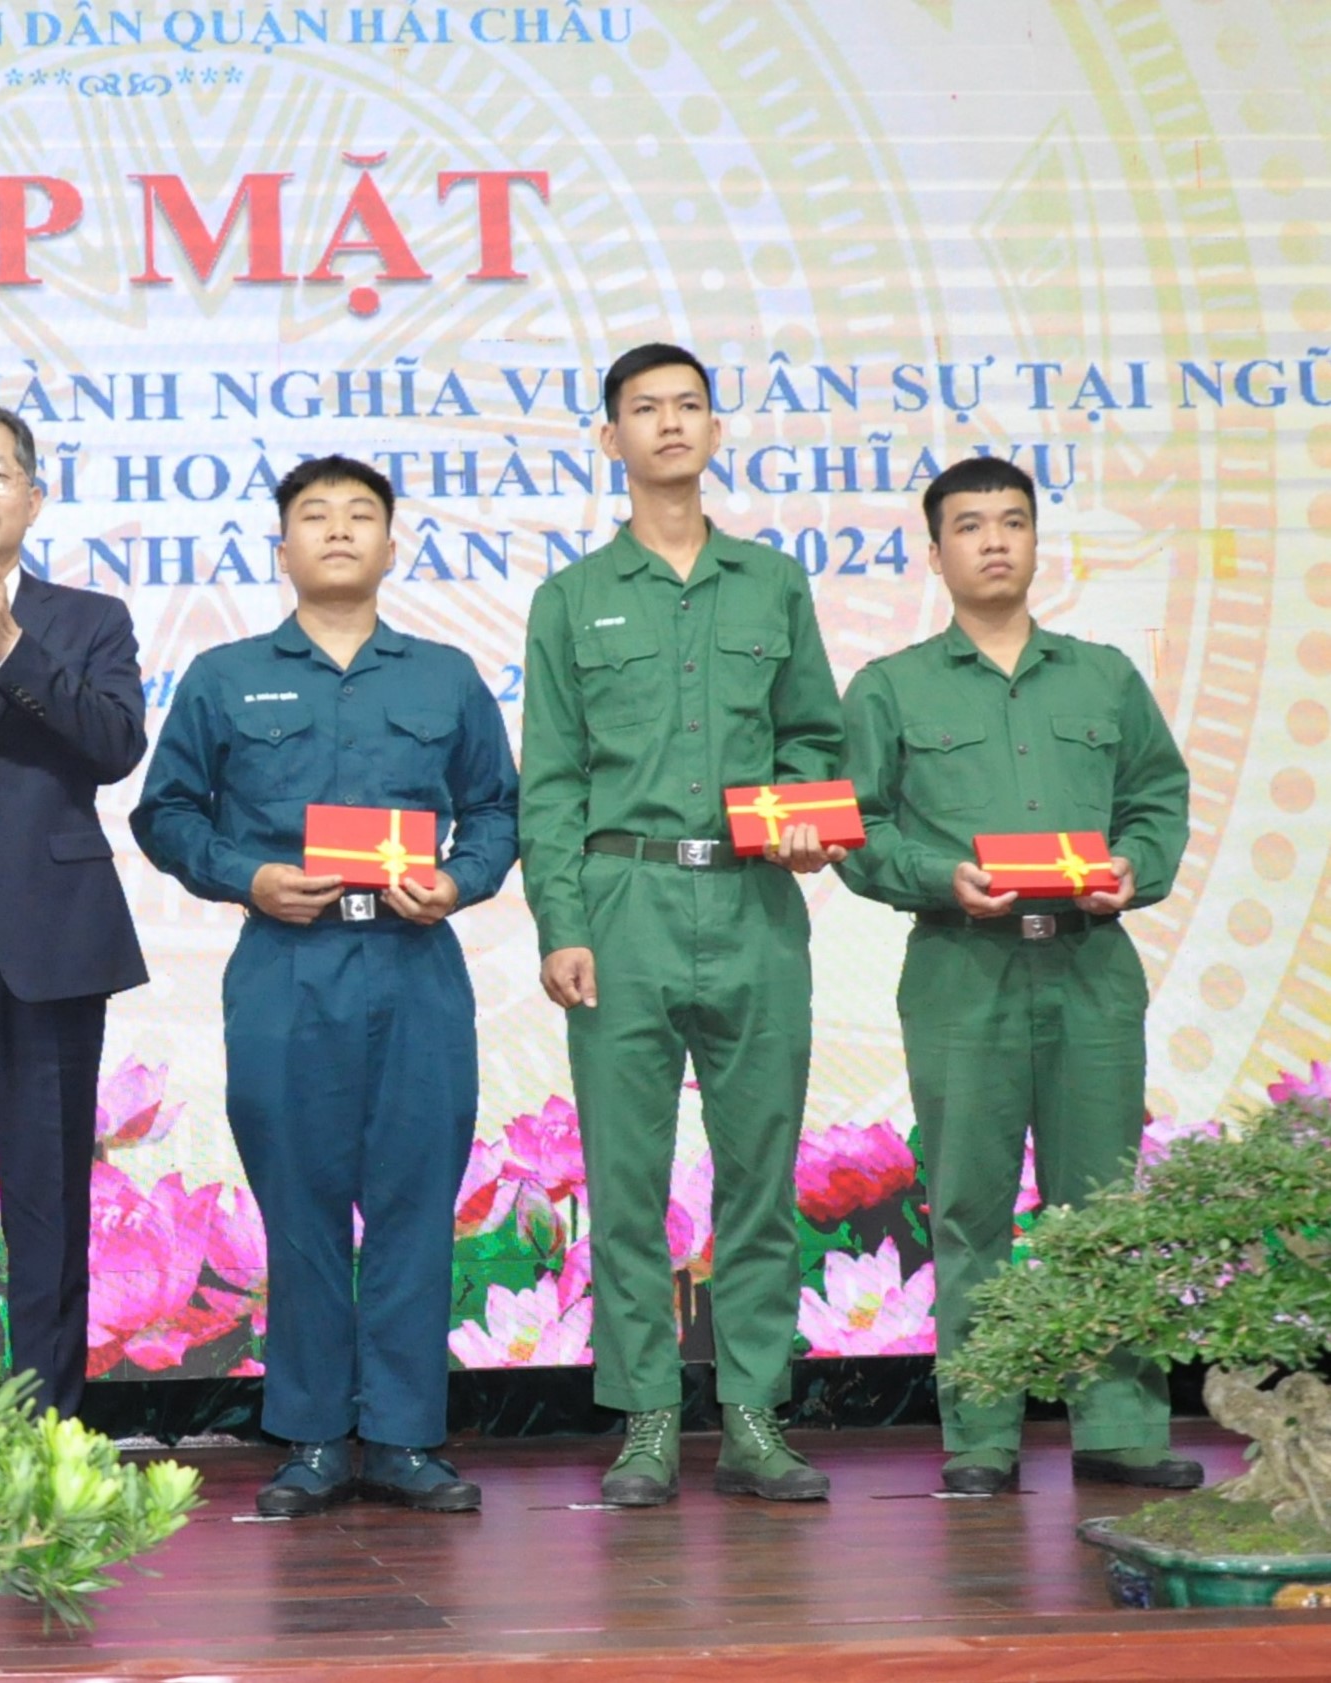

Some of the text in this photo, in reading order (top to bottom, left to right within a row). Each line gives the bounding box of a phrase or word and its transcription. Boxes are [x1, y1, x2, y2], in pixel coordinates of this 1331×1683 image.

[24, 0, 143, 47] DÂN
[128, 150, 551, 316] MẶT
[211, 356, 480, 420] NGHĨA
[501, 367, 607, 428] VỤ
[706, 351, 860, 414] UÂN
[893, 354, 996, 424] SỰ
[1017, 360, 1154, 422] TẠI
[115, 437, 343, 502] HOÀ
[700, 431, 944, 495] NGHĨA
[973, 444, 1076, 504] Ụ
[384, 517, 511, 583] ÂN
